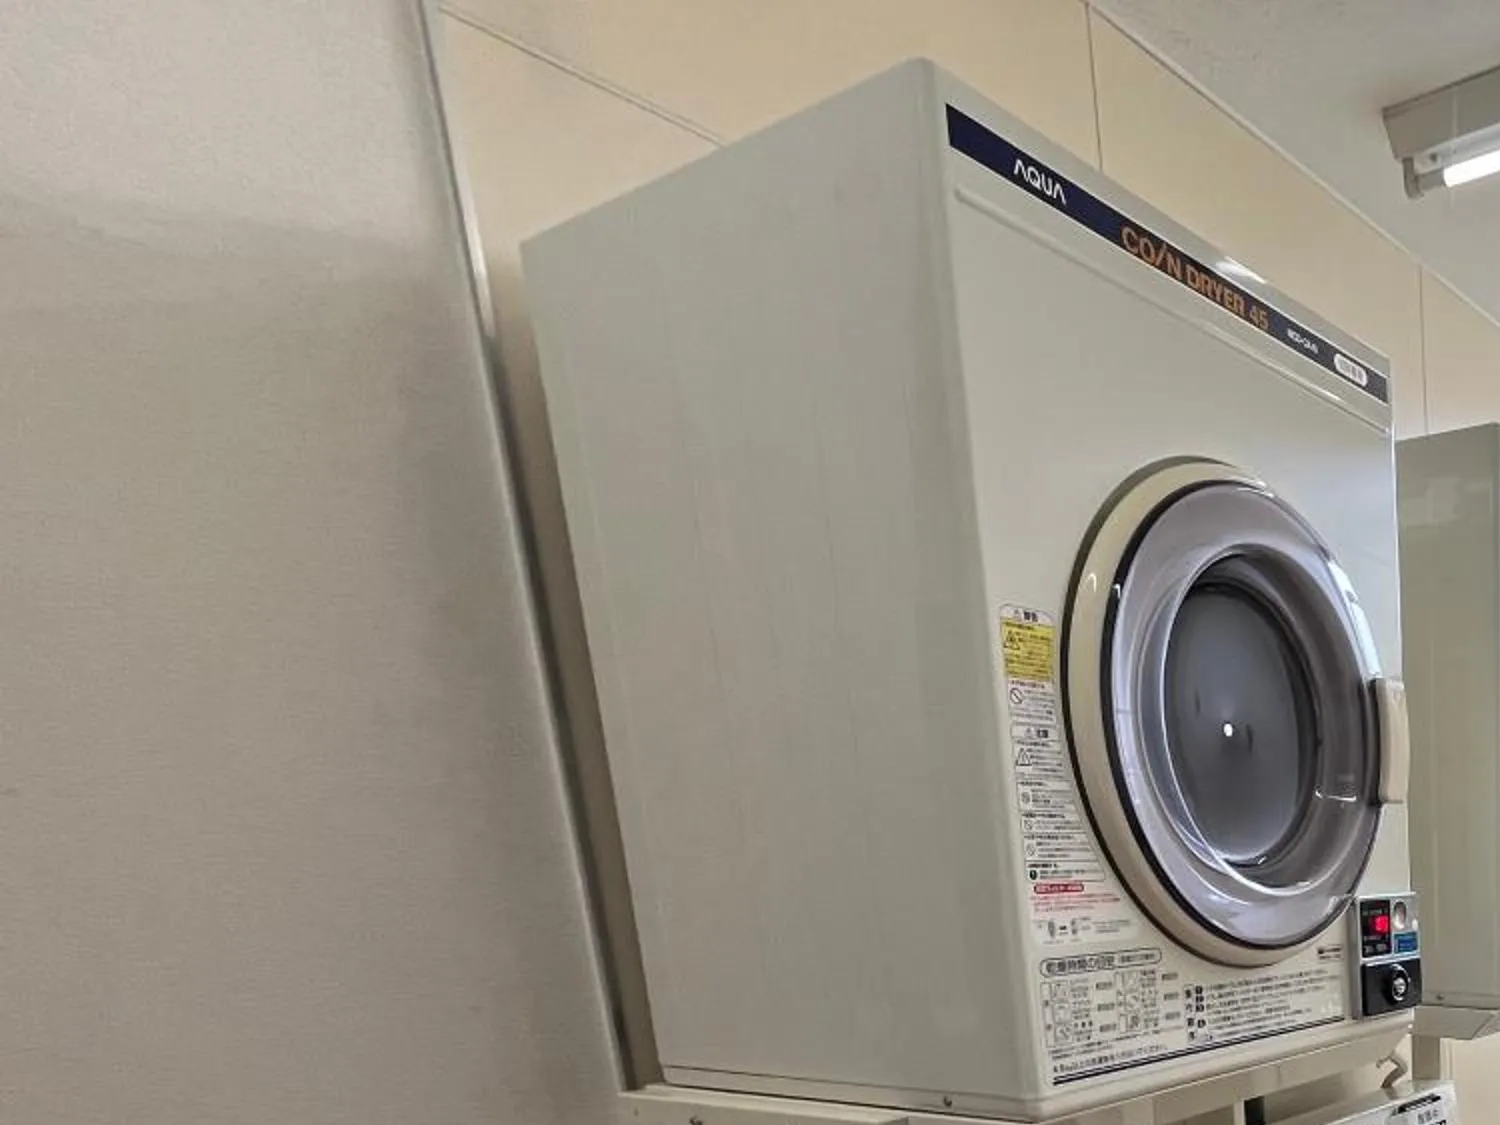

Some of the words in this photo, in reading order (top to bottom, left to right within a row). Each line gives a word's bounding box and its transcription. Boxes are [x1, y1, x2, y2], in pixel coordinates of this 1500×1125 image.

[1014, 159, 1067, 205] AQUA
[1186, 264, 1246, 316] DRYER
[1250, 306, 1269, 331] 45
